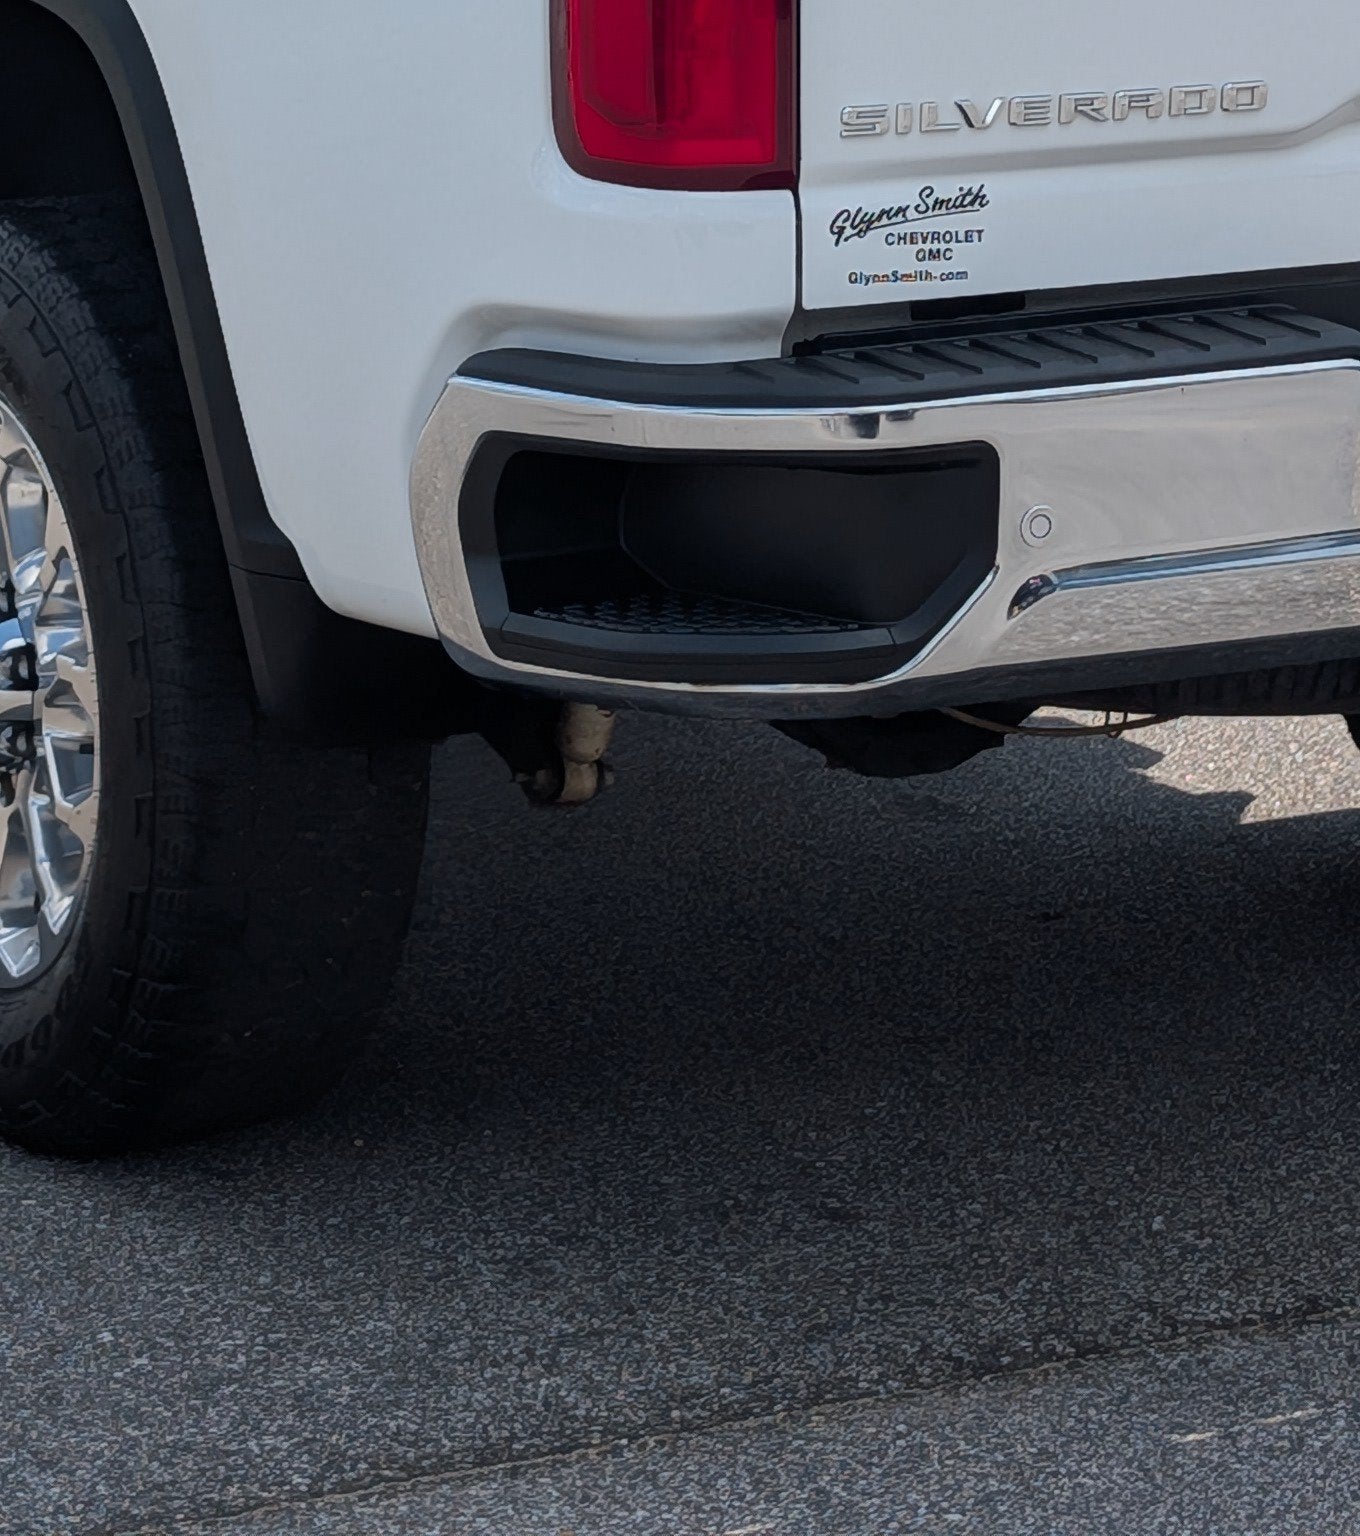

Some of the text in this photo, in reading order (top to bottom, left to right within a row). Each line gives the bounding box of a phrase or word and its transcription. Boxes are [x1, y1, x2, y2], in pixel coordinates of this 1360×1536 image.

[839, 79, 1269, 138] SILVERADO
[830, 184, 989, 246] Glynn Smith
[884, 228, 985, 246] CHEVROLET
[914, 247, 954, 262] GMC
